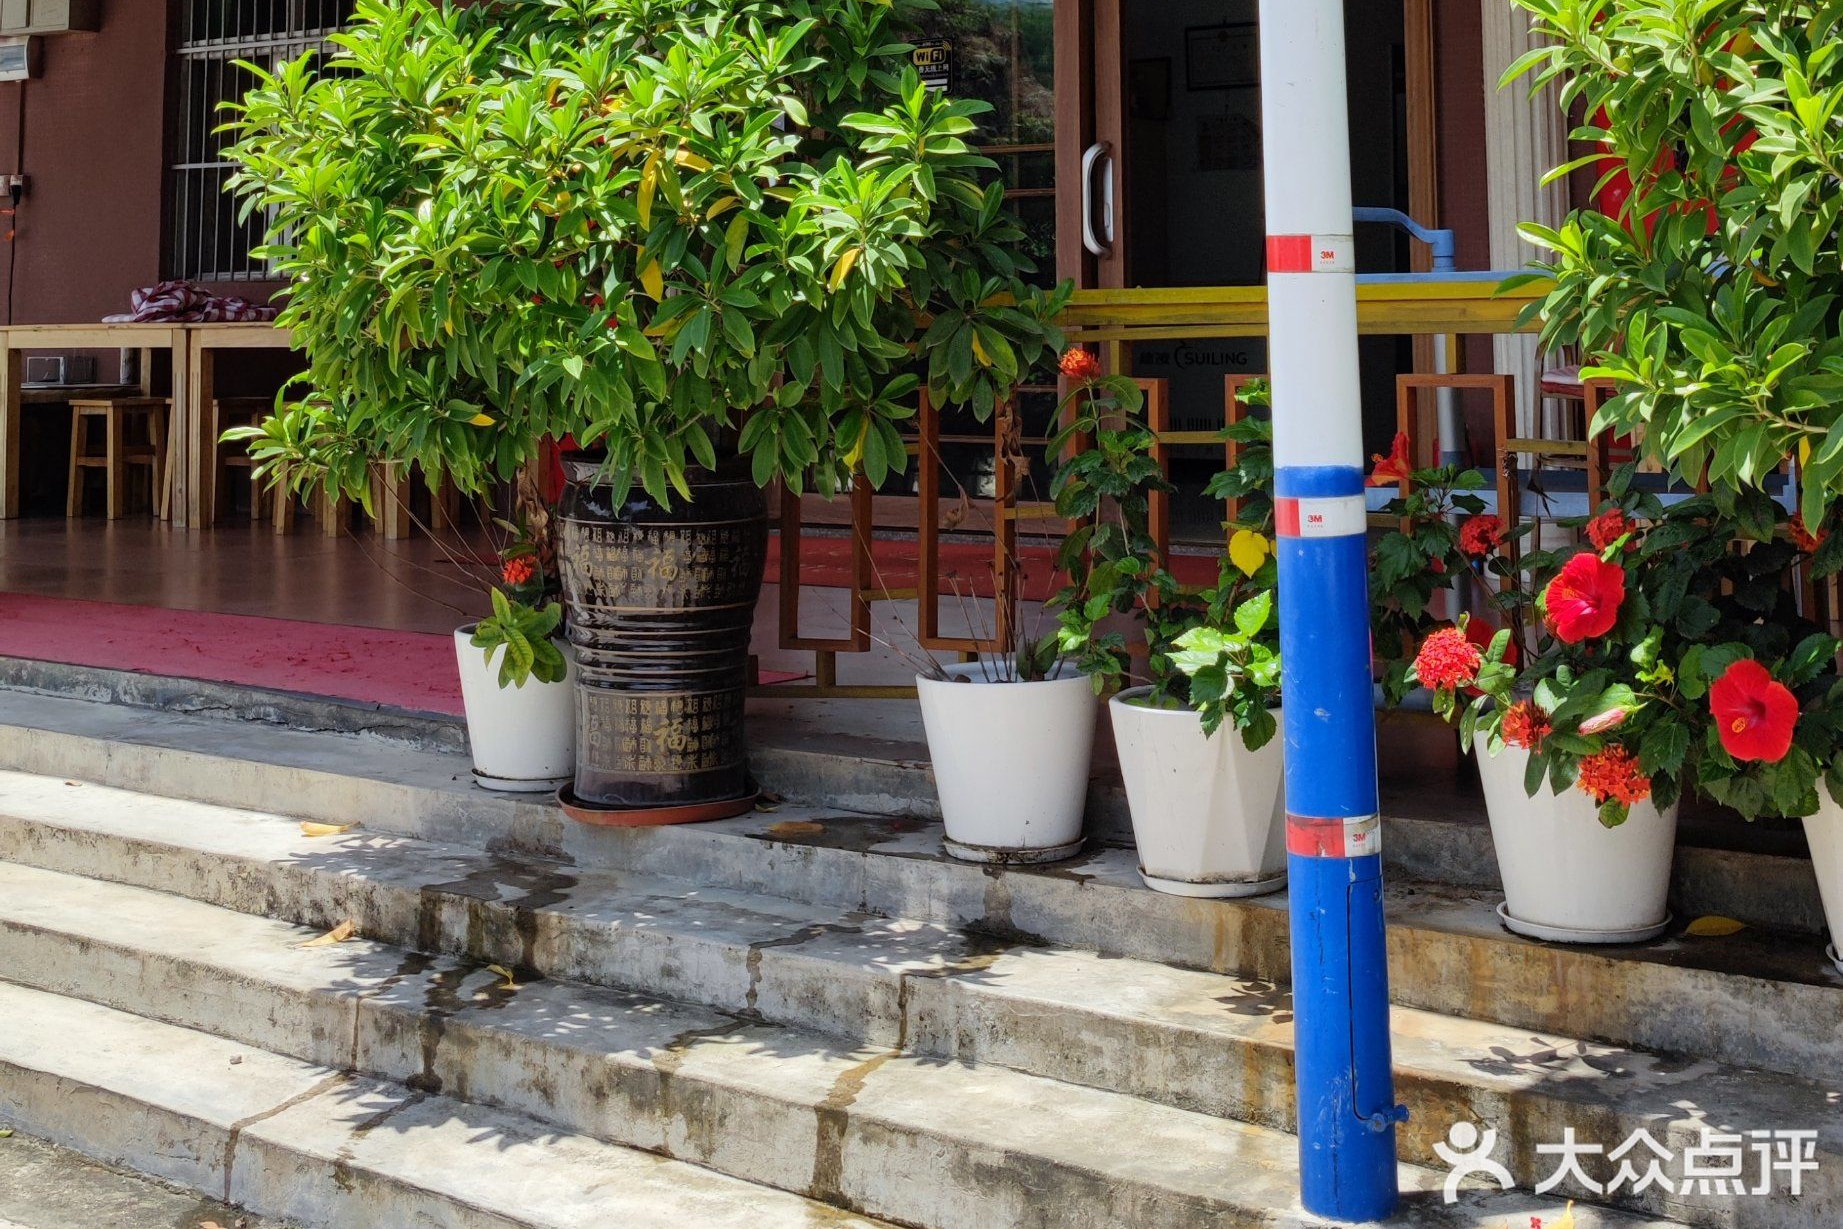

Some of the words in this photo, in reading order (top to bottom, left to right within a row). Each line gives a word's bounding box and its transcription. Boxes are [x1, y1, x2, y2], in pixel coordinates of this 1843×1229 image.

[1320, 251, 1335, 259] 3M
[1185, 351, 1248, 366] SUILING
[1307, 514, 1323, 523] 3M
[644, 547, 679, 582] 福
[652, 717, 688, 752] 福
[1352, 833, 1366, 842] 3M
